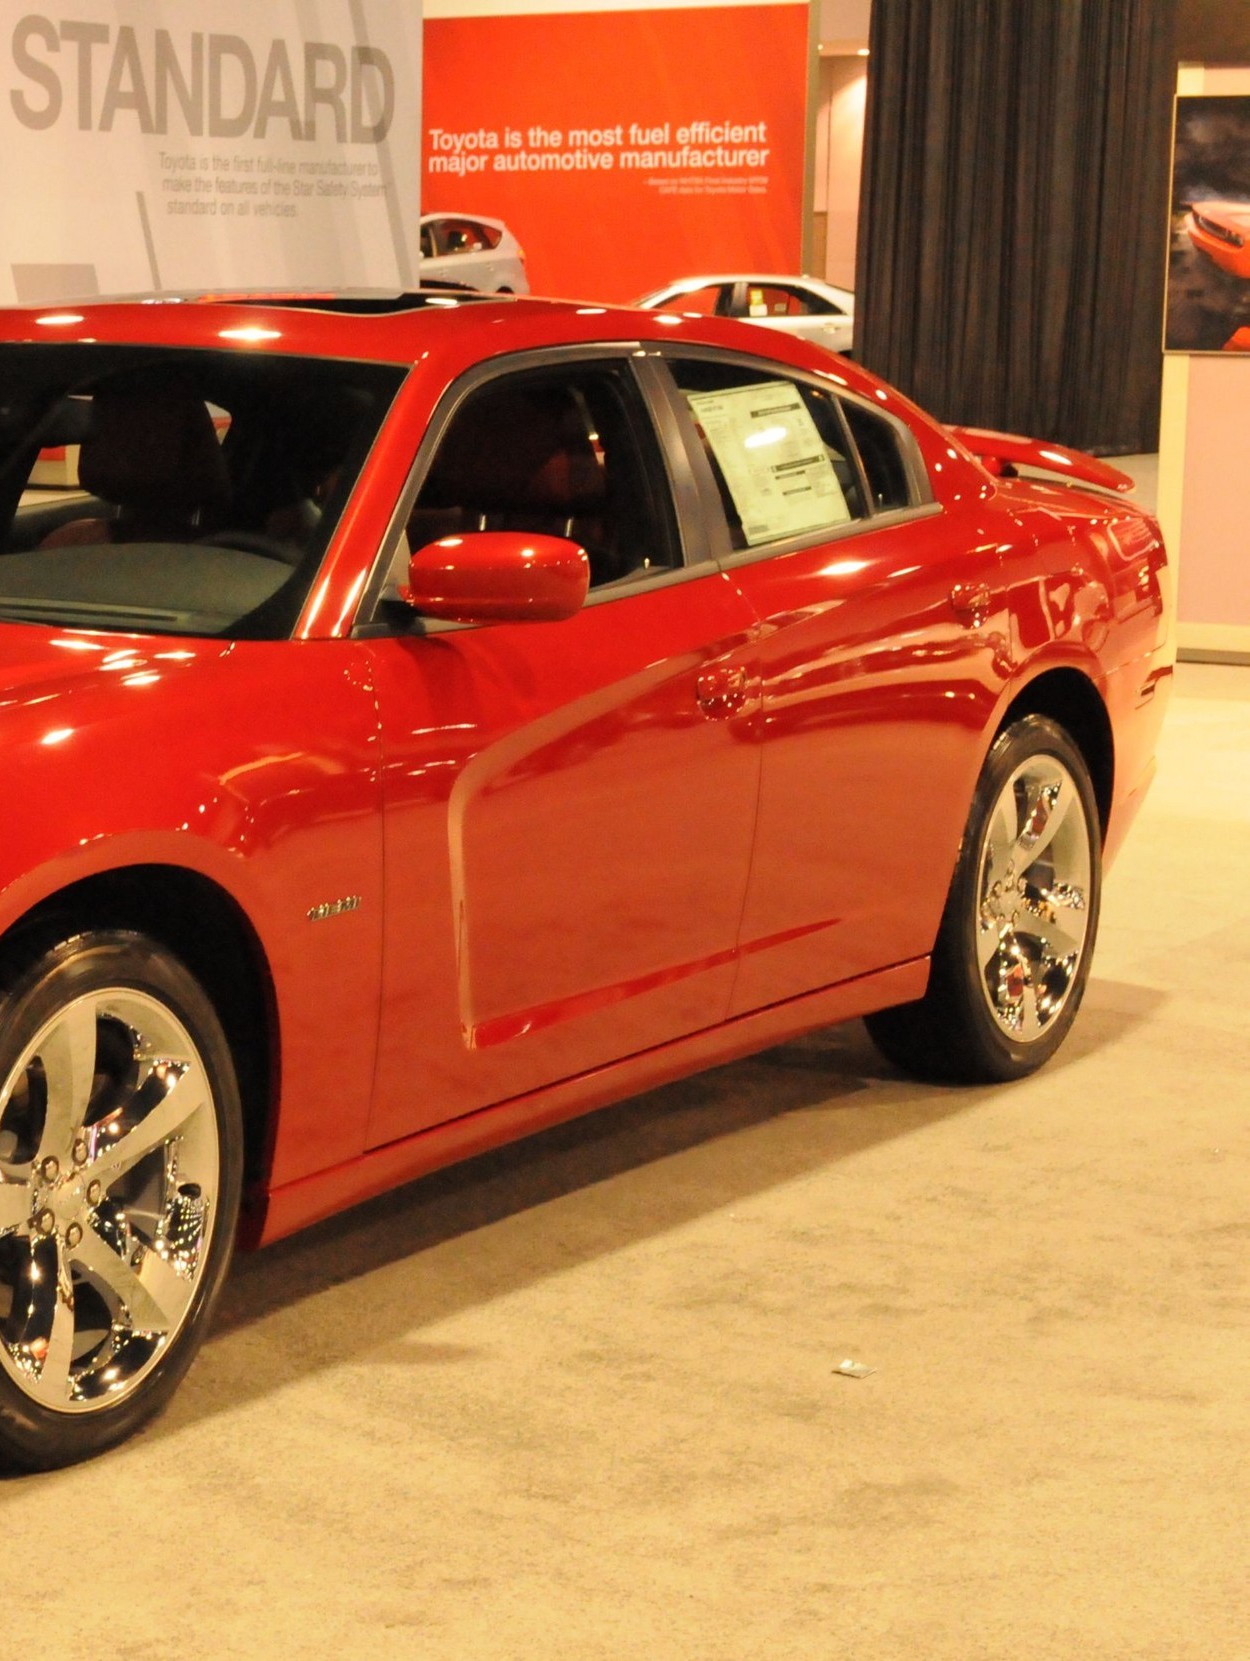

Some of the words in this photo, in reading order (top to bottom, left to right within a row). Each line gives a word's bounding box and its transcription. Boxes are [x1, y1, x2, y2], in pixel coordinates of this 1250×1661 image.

[10, 14, 395, 143] STANDARD
[428, 128, 499, 155] Toyota
[504, 127, 522, 148] is
[527, 125, 562, 148] the
[568, 123, 623, 147] most
[629, 121, 670, 146] fuel
[676, 120, 767, 145] efficient
[159, 151, 196, 173] Toyota
[199, 156, 209, 171] is
[212, 155, 230, 172] the
[233, 155, 254, 173] first
[428, 150, 488, 177] major
[493, 148, 614, 172] automotive
[619, 145, 770, 169] manufacturer
[162, 177, 192, 193] make
[194, 177, 213, 193] the
[215, 176, 258, 194] features
[260, 178, 272, 195] of
[274, 180, 291, 196] the
[167, 198, 216, 216] standard
[220, 201, 235, 216] on
[237, 199, 251, 217] all
